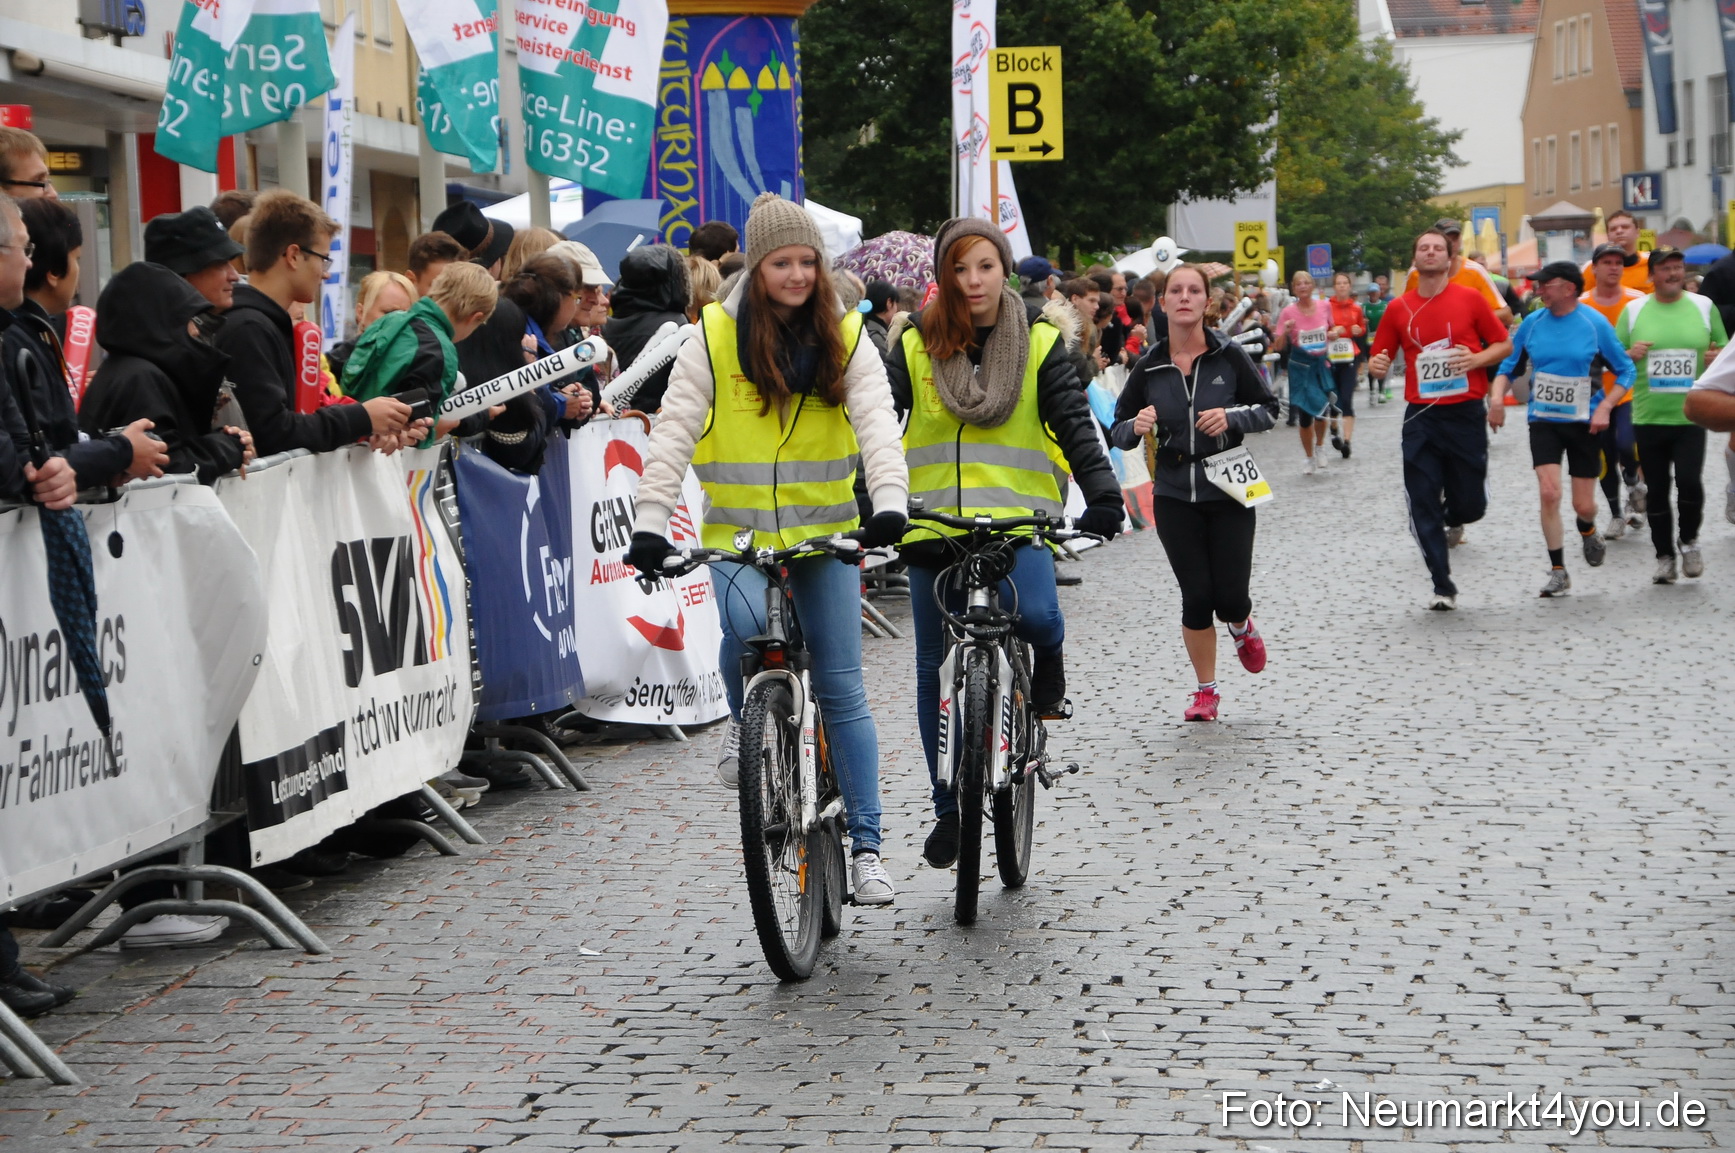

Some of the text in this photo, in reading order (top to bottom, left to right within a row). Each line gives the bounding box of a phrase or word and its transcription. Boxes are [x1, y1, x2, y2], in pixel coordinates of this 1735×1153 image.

[996, 52, 1053, 73] Block
[1007, 82, 1044, 136] B
[540, 129, 610, 175] 6352
[1238, 223, 1264, 232] Block
[1243, 235, 1259, 259] C
[1311, 267, 1331, 276] TAXI
[518, 354, 565, 388] BMW
[1421, 361, 1455, 380] 228
[1653, 360, 1692, 376] 2836
[1536, 383, 1575, 404] 2558
[1221, 458, 1259, 484] 138
